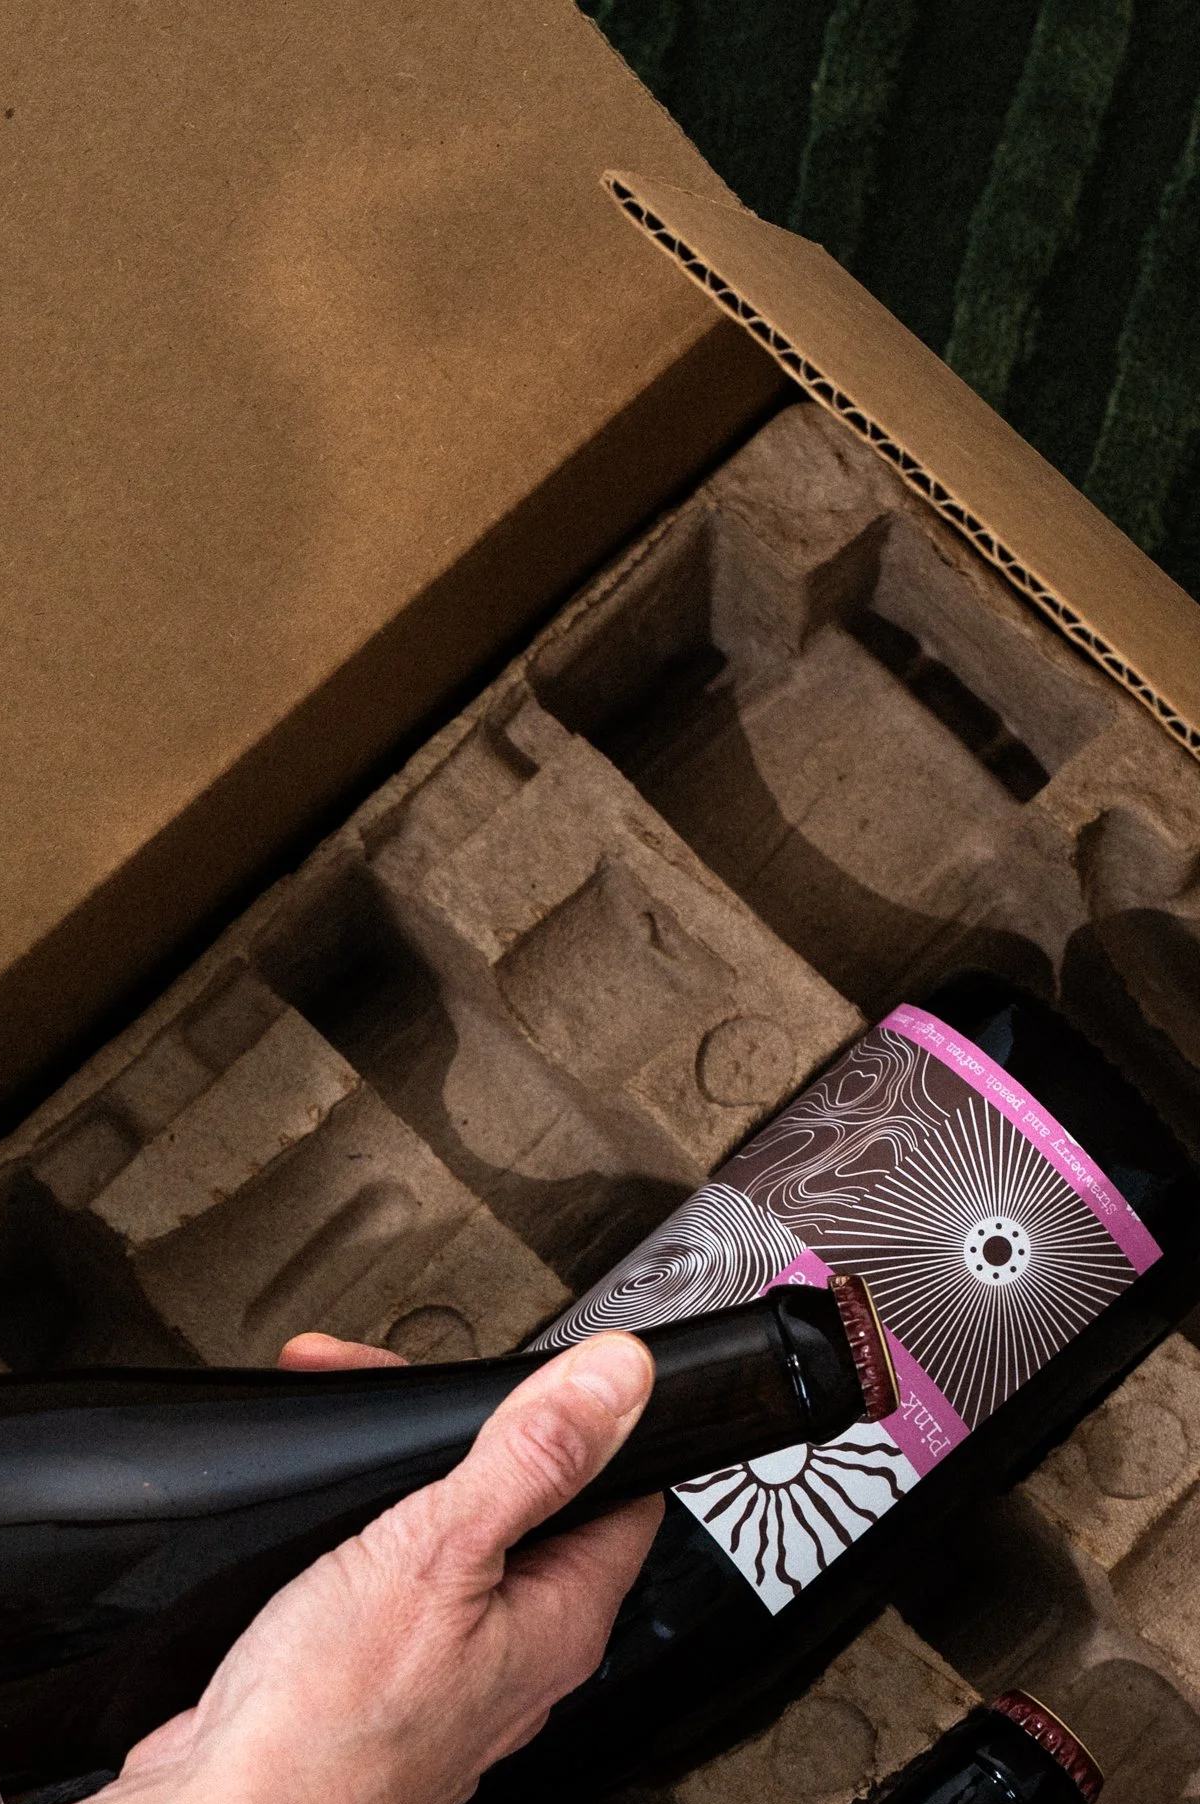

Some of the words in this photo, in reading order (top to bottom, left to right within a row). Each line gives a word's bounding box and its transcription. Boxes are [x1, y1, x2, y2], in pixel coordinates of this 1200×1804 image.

[912, 1022, 945, 1047] bright
[946, 1042, 985, 1075] soften
[986, 1074, 1026, 1111] peach
[1022, 1111, 1050, 1137] and
[1052, 1139, 1117, 1215] Strawberry
[901, 1391, 951, 1458] Pink
